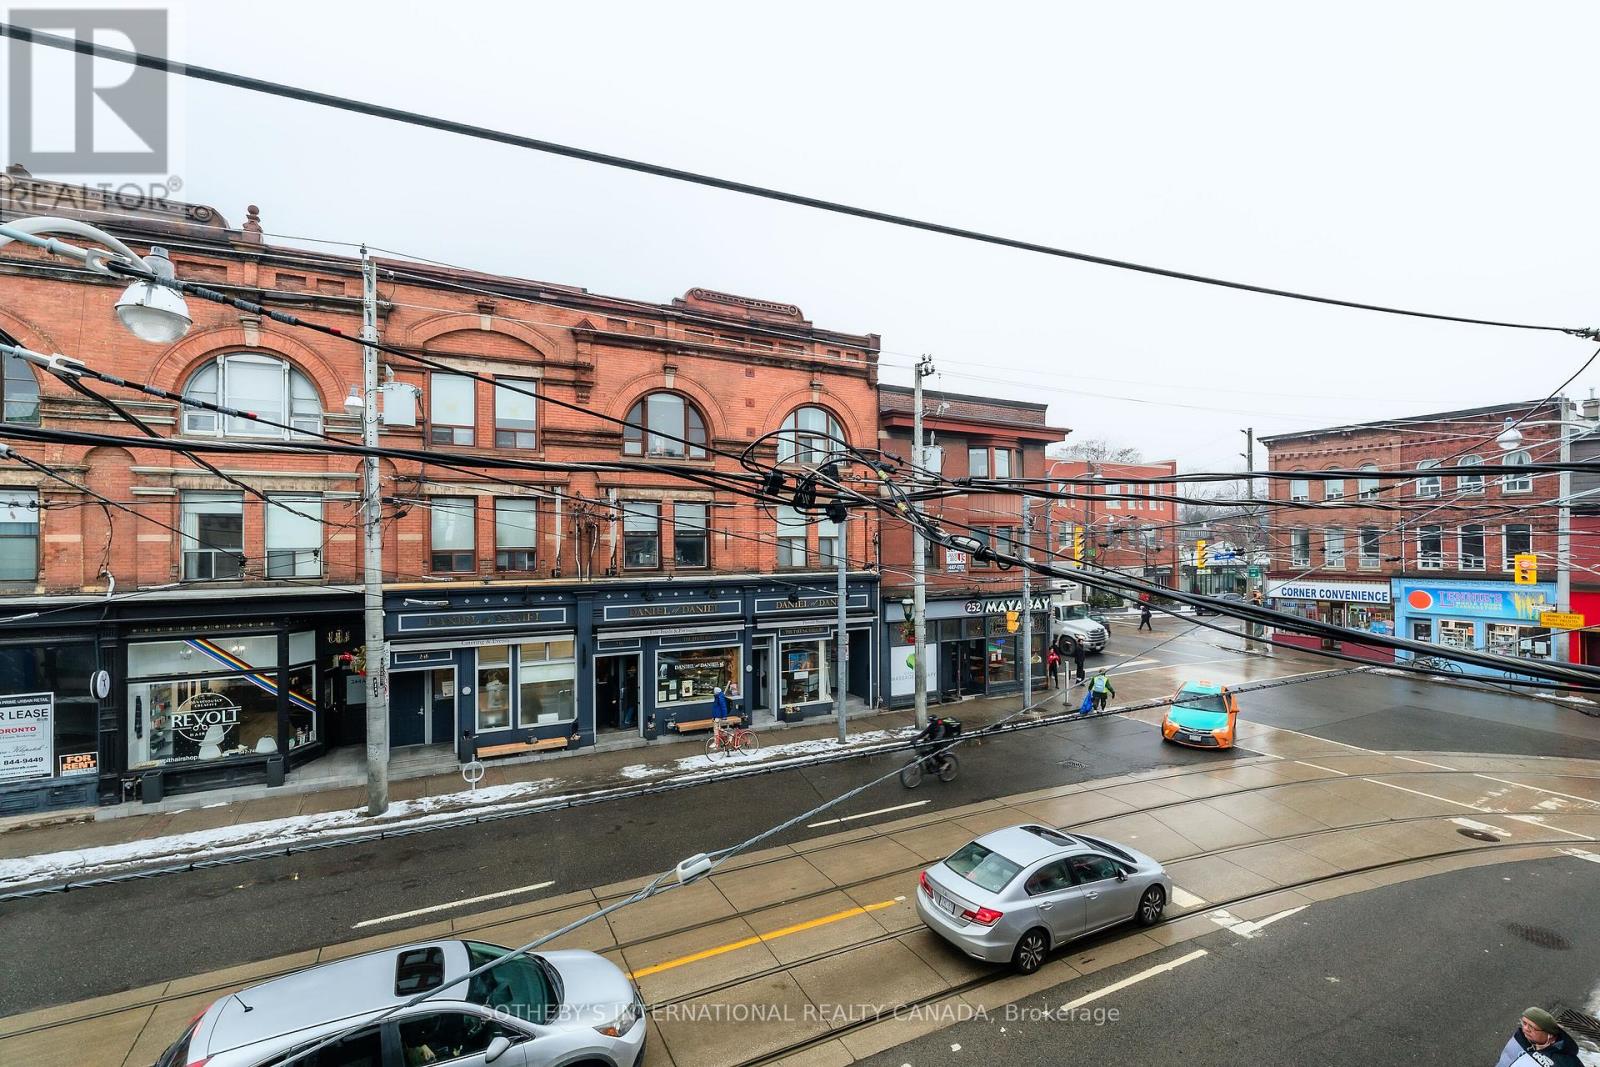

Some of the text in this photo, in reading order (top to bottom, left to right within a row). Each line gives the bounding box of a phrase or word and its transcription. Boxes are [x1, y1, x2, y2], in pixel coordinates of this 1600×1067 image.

[1281, 587, 1388, 602] CORNER CONVENIENCE
[775, 600, 807, 609] DANIEL
[966, 602, 981, 612] 252
[985, 598, 1050, 613] MAYA BAY
[674, 662, 695, 671] DANIEL
[9, 708, 49, 720] LEASE
[171, 709, 238, 729] REVOLT
[0, 726, 37, 735] ORONTO
[4, 756, 44, 766] 844-9449
[66, 754, 92, 763] FOR
[63, 760, 97, 771] RENT
